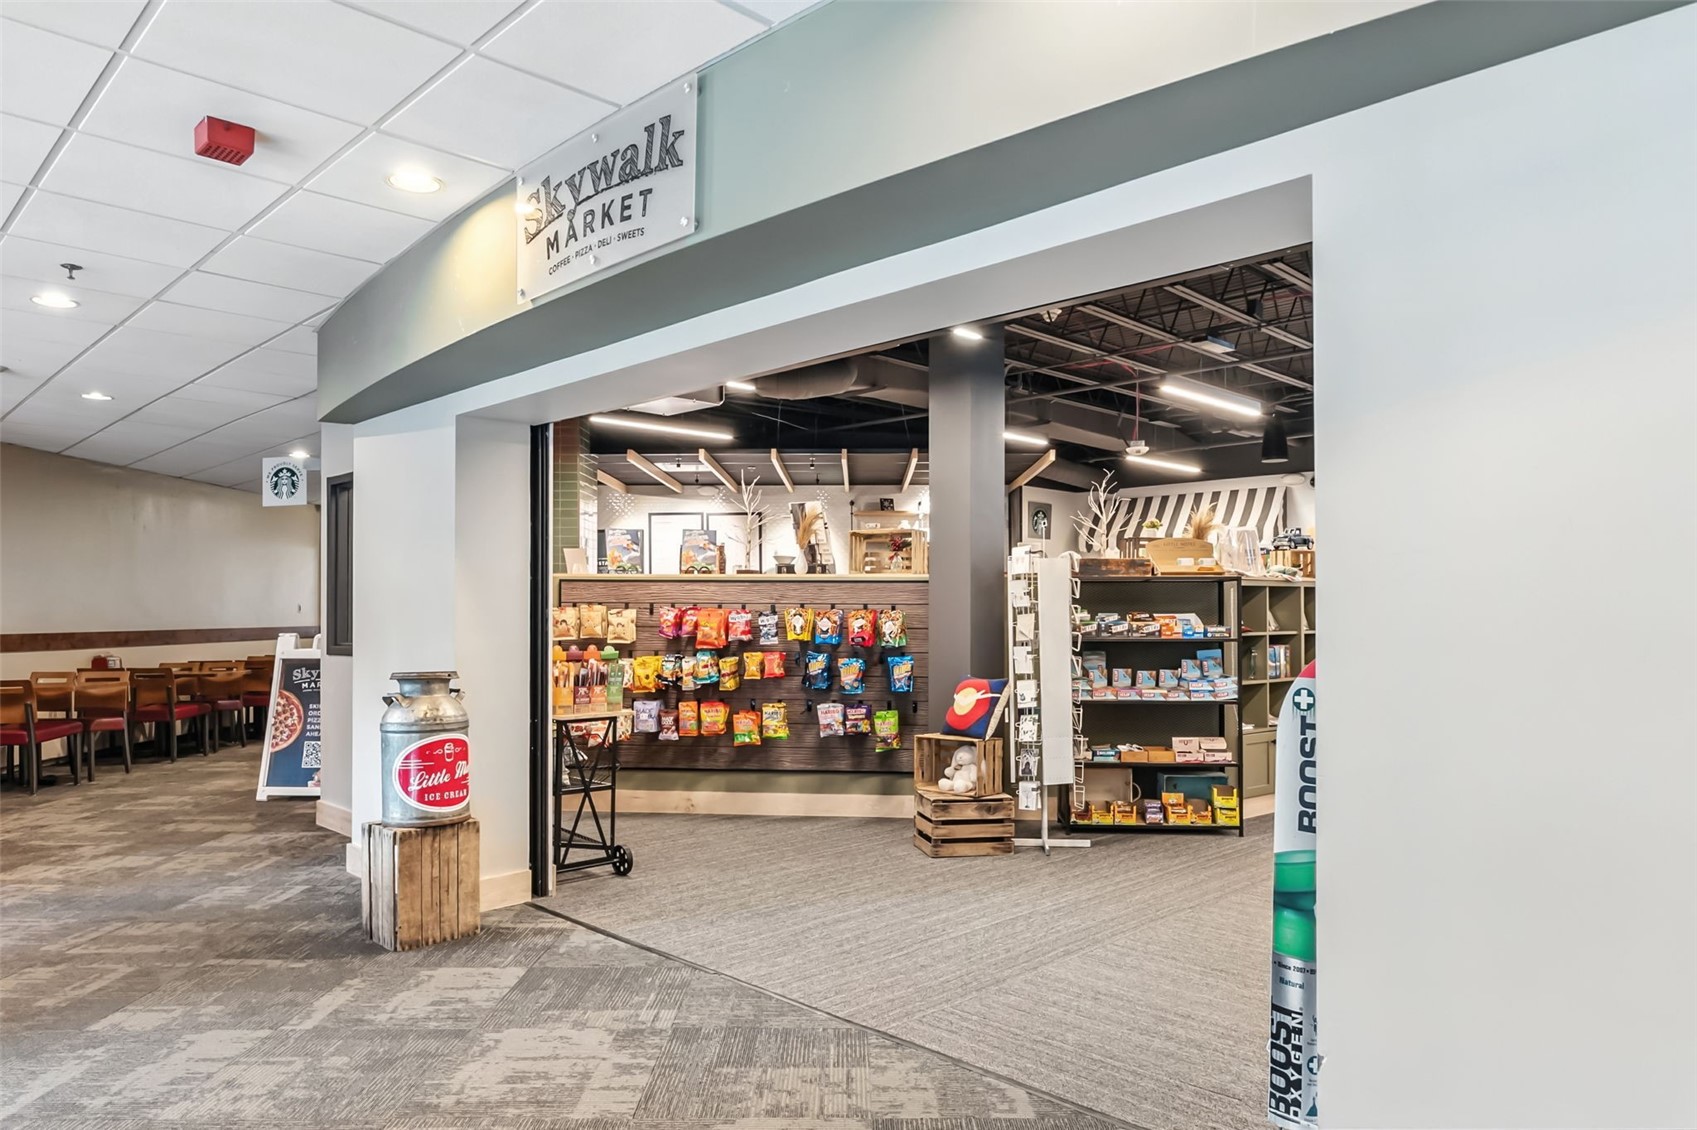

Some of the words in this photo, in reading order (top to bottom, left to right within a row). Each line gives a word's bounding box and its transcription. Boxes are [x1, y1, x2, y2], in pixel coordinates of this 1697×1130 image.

[524, 114, 685, 245] Skywalk
[546, 188, 653, 260] MARKET
[548, 255, 571, 276] COFFEE
[575, 244, 593, 259] PIZZA
[597, 236, 612, 249] DELI
[616, 227, 645, 242] SWEETS
[408, 769, 451, 792] Little
[424, 793, 441, 801] ICE
[1279, 976, 1305, 990] Natural
